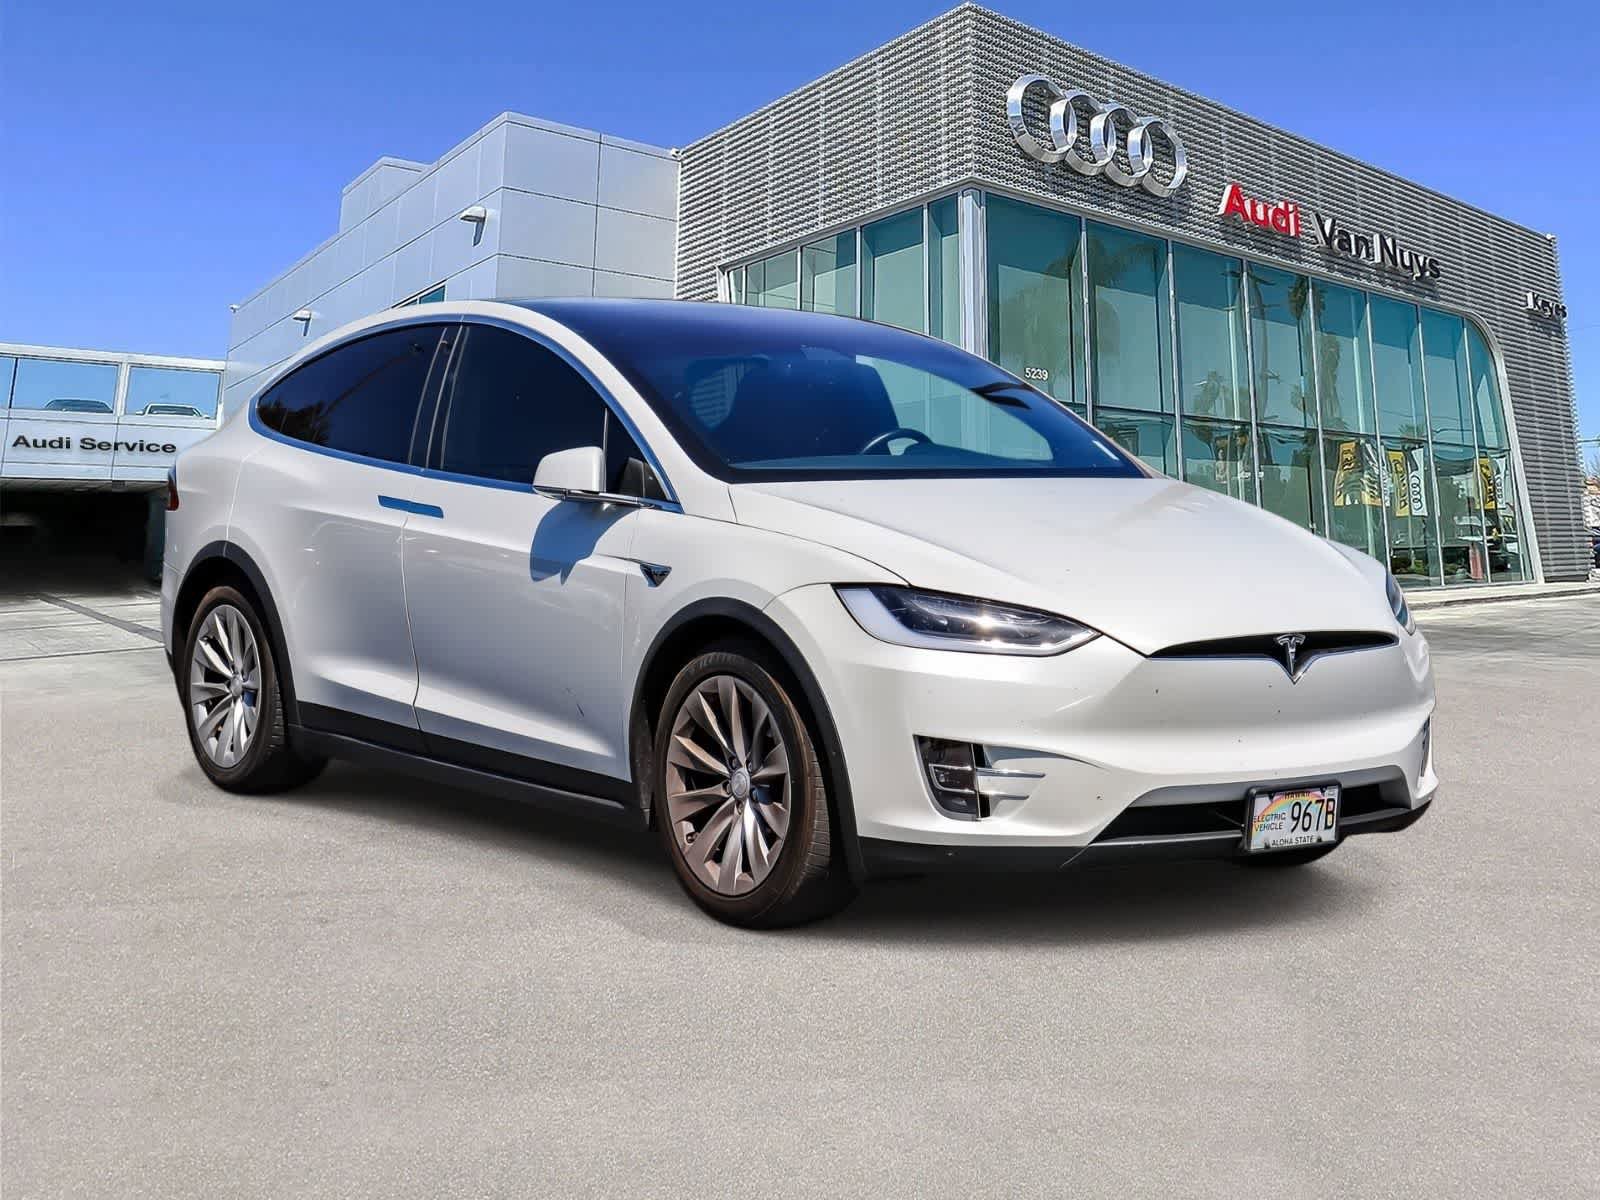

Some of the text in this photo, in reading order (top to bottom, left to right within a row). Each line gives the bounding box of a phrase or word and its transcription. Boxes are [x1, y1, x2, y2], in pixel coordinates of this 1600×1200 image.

[1218, 183, 1441, 281] Audi Van Nuys
[1025, 367, 1048, 380] 5239
[12, 435, 177, 454] Audi Service
[1253, 812, 1286, 823] ELECTRIC
[1291, 799, 1335, 833] 967B
[1254, 822, 1283, 831] VEHICLE
[1272, 835, 1313, 846] ALOHA STATE
